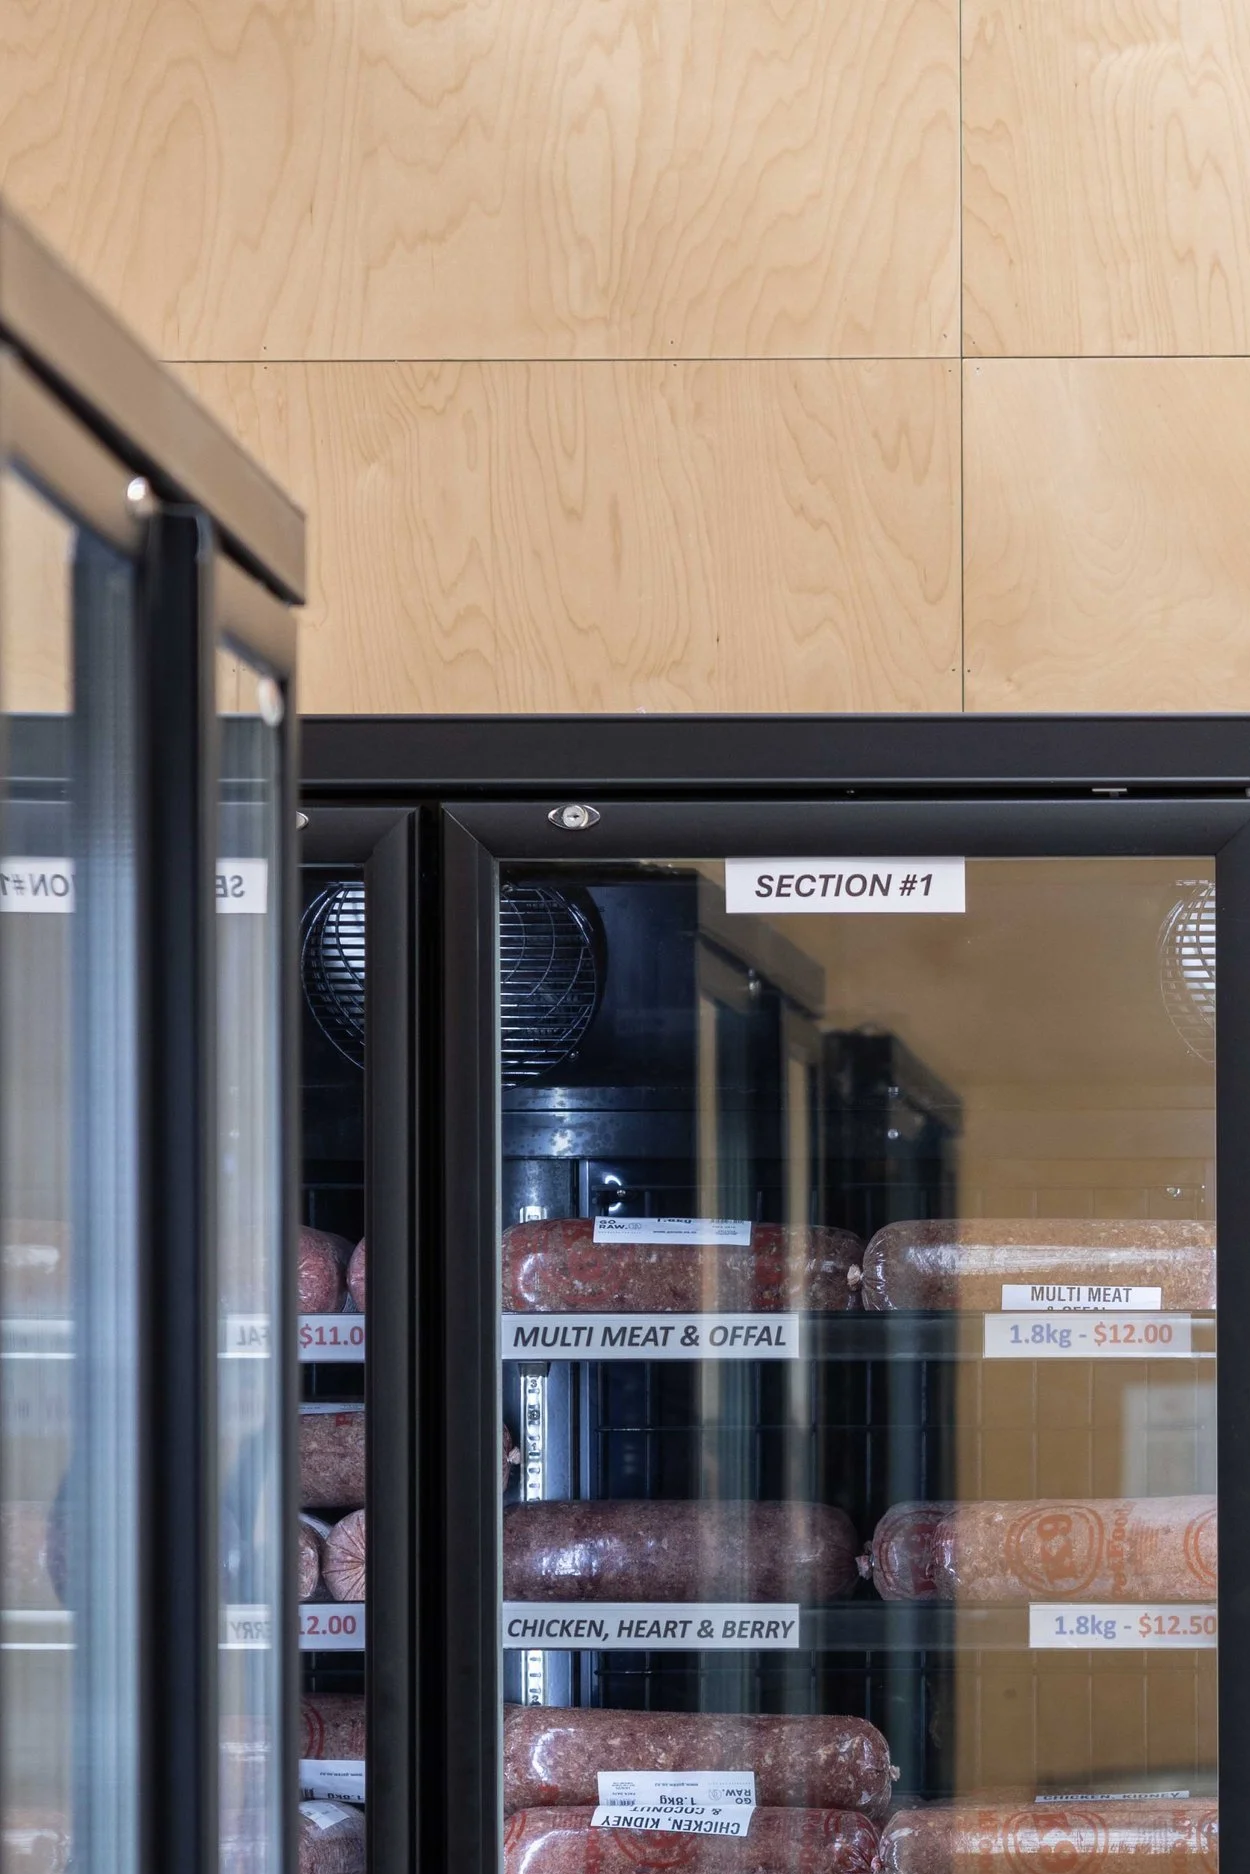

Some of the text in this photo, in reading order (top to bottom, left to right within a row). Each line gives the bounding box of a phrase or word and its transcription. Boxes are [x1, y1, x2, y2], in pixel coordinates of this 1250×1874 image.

[755, 873, 933, 899] SECTION #1
[1031, 1286, 1132, 1303] MULTI MEAT
[513, 1325, 787, 1347] MULTI MEAT & OFFAL
[1010, 1322, 1072, 1348] 1.8kg
[1094, 1321, 1173, 1347] $12.00
[507, 1618, 796, 1644] CHICKEN, HEART & BERRY
[1054, 1614, 1116, 1639] 1.8kg
[1138, 1613, 1217, 1638] $12.50
[660, 1795, 696, 1806] 1.8kg
[722, 1789, 751, 1797] RAW.
[629, 1806, 704, 1815] COCONUT
[601, 1815, 741, 1834] CHICKEN, KIDNEY
